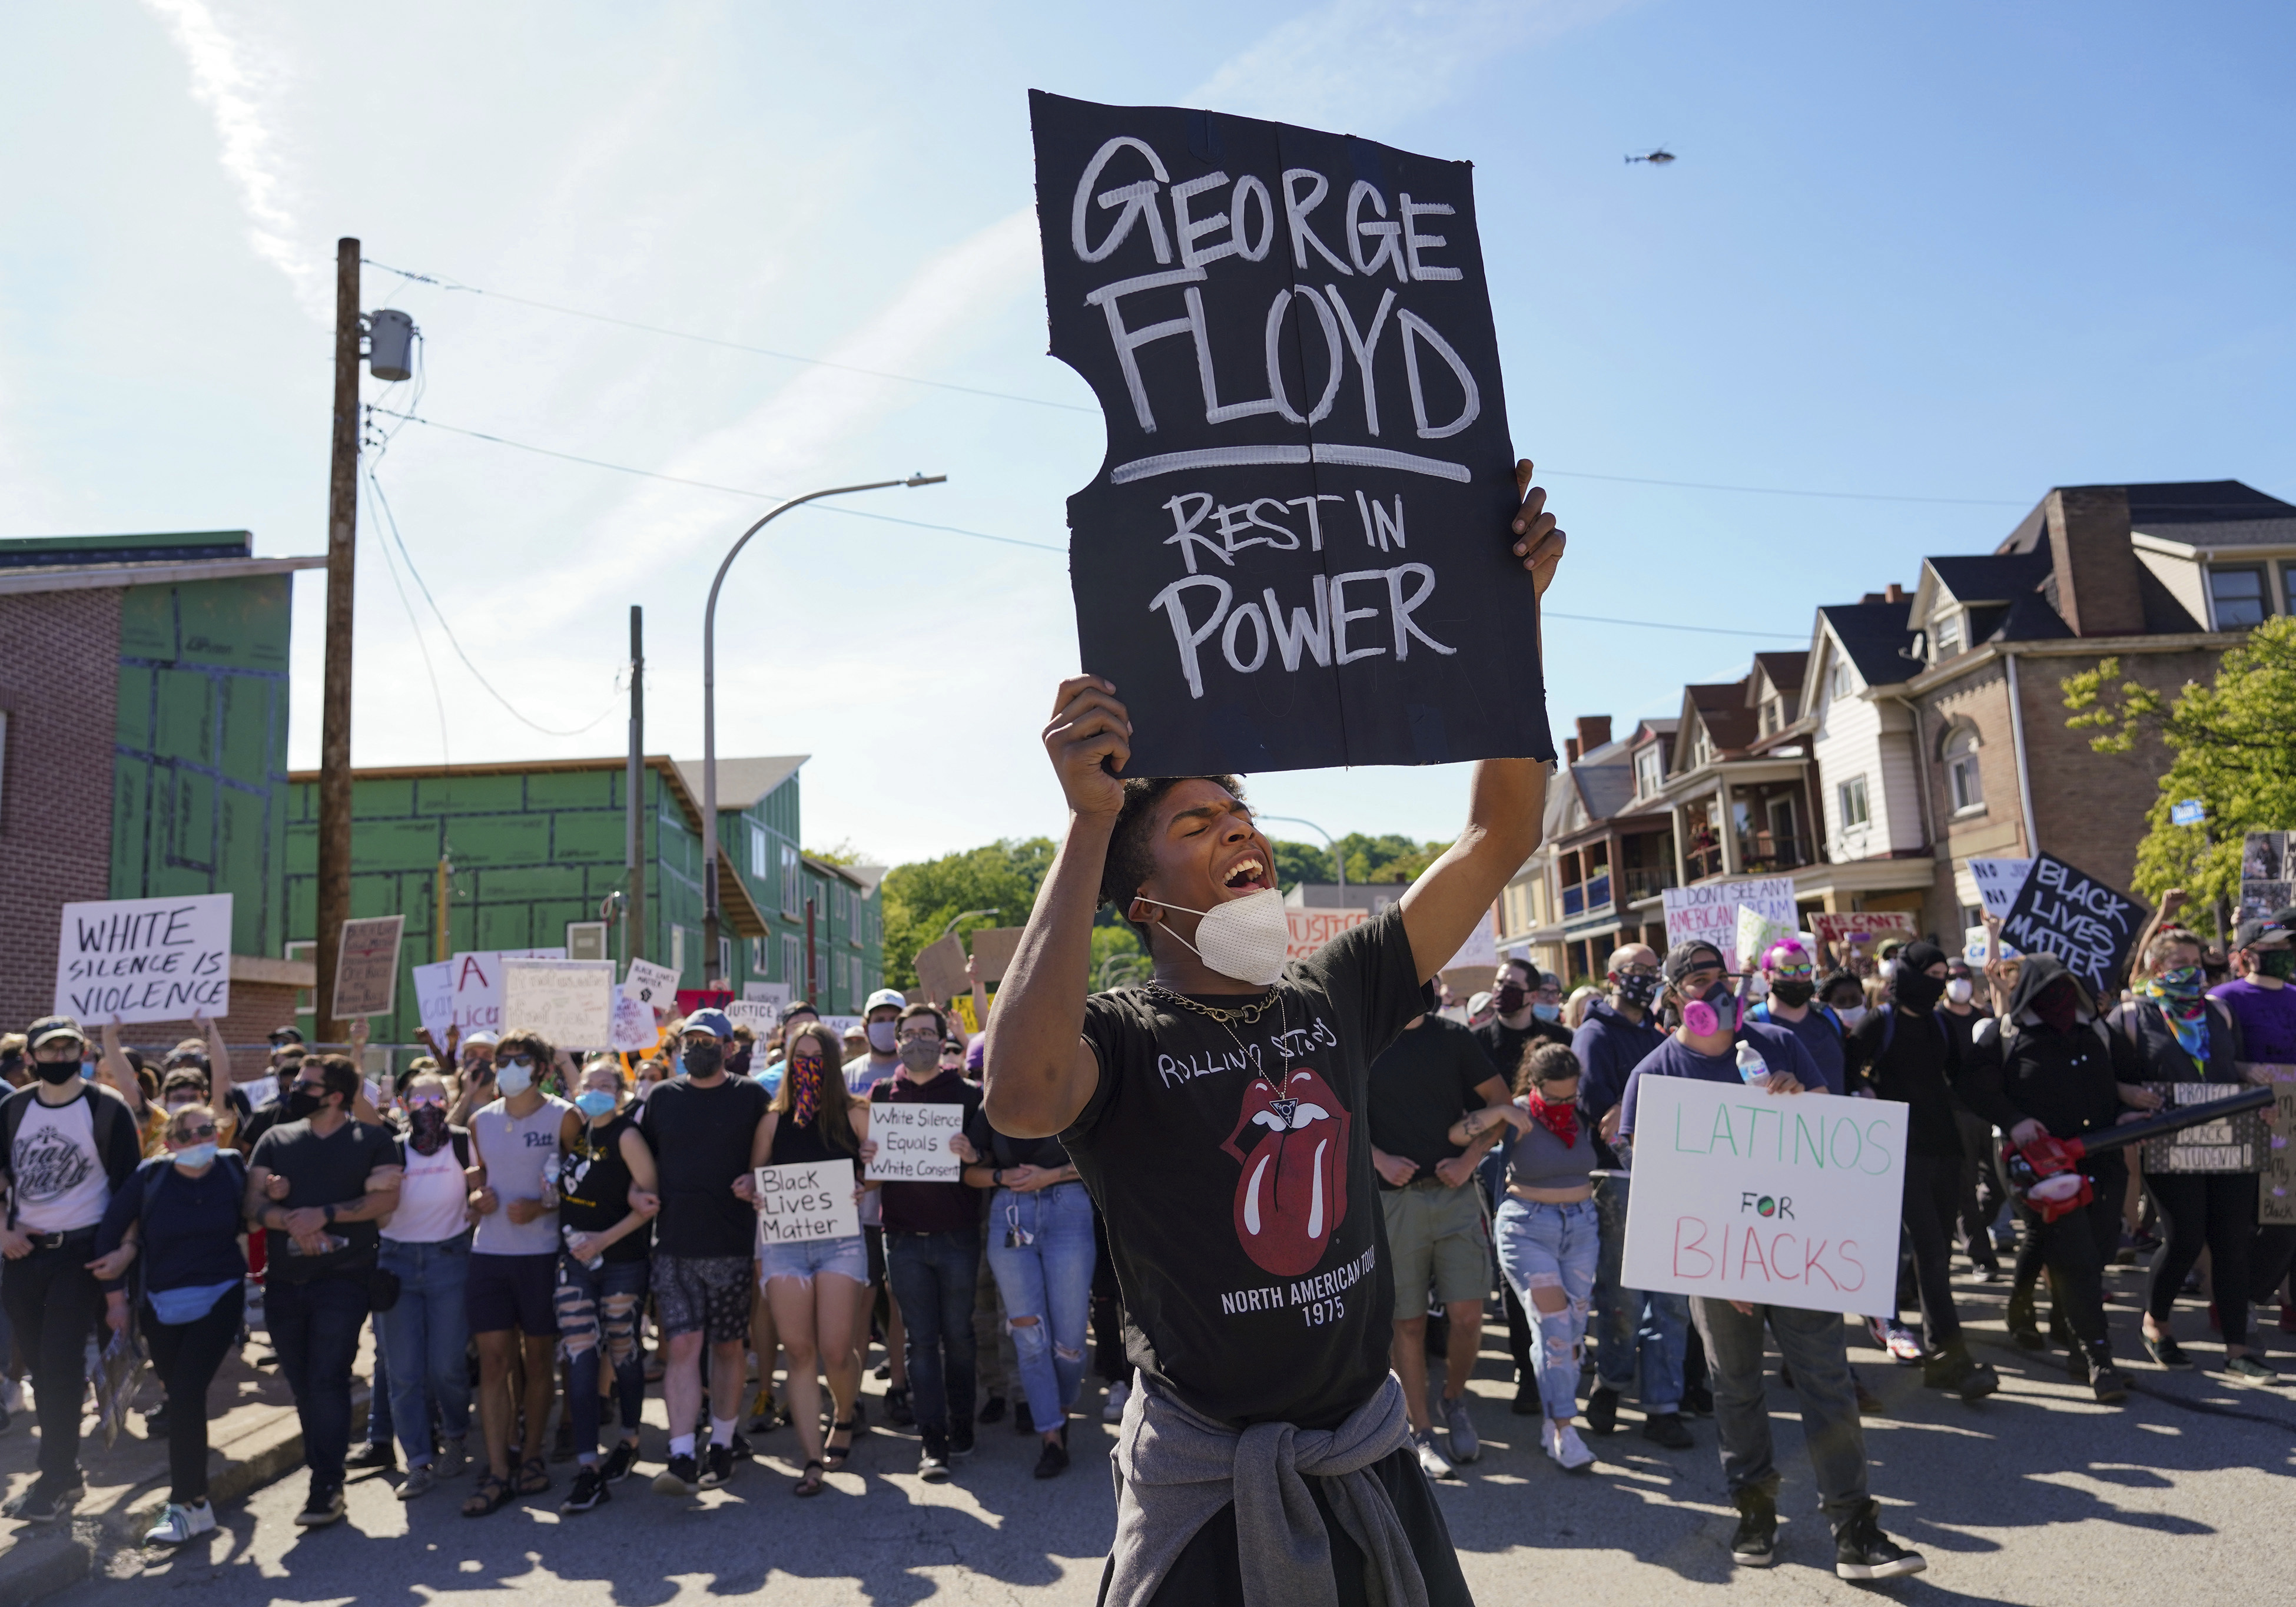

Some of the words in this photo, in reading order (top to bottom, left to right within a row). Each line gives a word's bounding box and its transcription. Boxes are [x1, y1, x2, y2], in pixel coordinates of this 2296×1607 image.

[1073, 136, 1463, 283] GEORGE
[1084, 267, 1480, 440] FLOYD
[1162, 492, 1345, 573] REST
[1355, 490, 1406, 552] IN
[1149, 562, 1458, 699] POWER
[1667, 887, 1683, 909] I
[1731, 881, 1756, 900] SEE
[1760, 879, 1789, 897] ANY
[2036, 858, 2129, 935] BLACK
[78, 906, 197, 953] WHITE
[1668, 904, 1734, 933] AMERICAN
[2030, 890, 2116, 956] LIVES
[1708, 927, 1734, 946] SEE
[2006, 914, 2111, 991] MATTER
[68, 952, 184, 982] SILENCE
[192, 950, 225, 976] IS
[458, 955, 489, 992] A
[70, 979, 228, 1016] VIOLENCE
[728, 1005, 772, 1018] JUSTICE
[1157, 1043, 1263, 1089] ROLLING
[872, 1106, 913, 1125] White
[918, 1108, 962, 1128] Silence
[523, 1131, 555, 1148] Pitt
[887, 1131, 938, 1155] Equals
[1675, 1102, 1892, 1175] LATINOS
[2179, 1125, 2225, 1144] BLACK
[762, 1169, 820, 1193] Black
[870, 1158, 914, 1177] White
[917, 1159, 961, 1177] Consent
[764, 1191, 832, 1215] Lives
[1741, 1192, 1795, 1221] FOR
[763, 1217, 838, 1241] Matter
[1220, 1286, 1284, 1315] NORTH
[1290, 1264, 1361, 1306] AMERICAN
[1302, 1295, 1345, 1327] 1975
